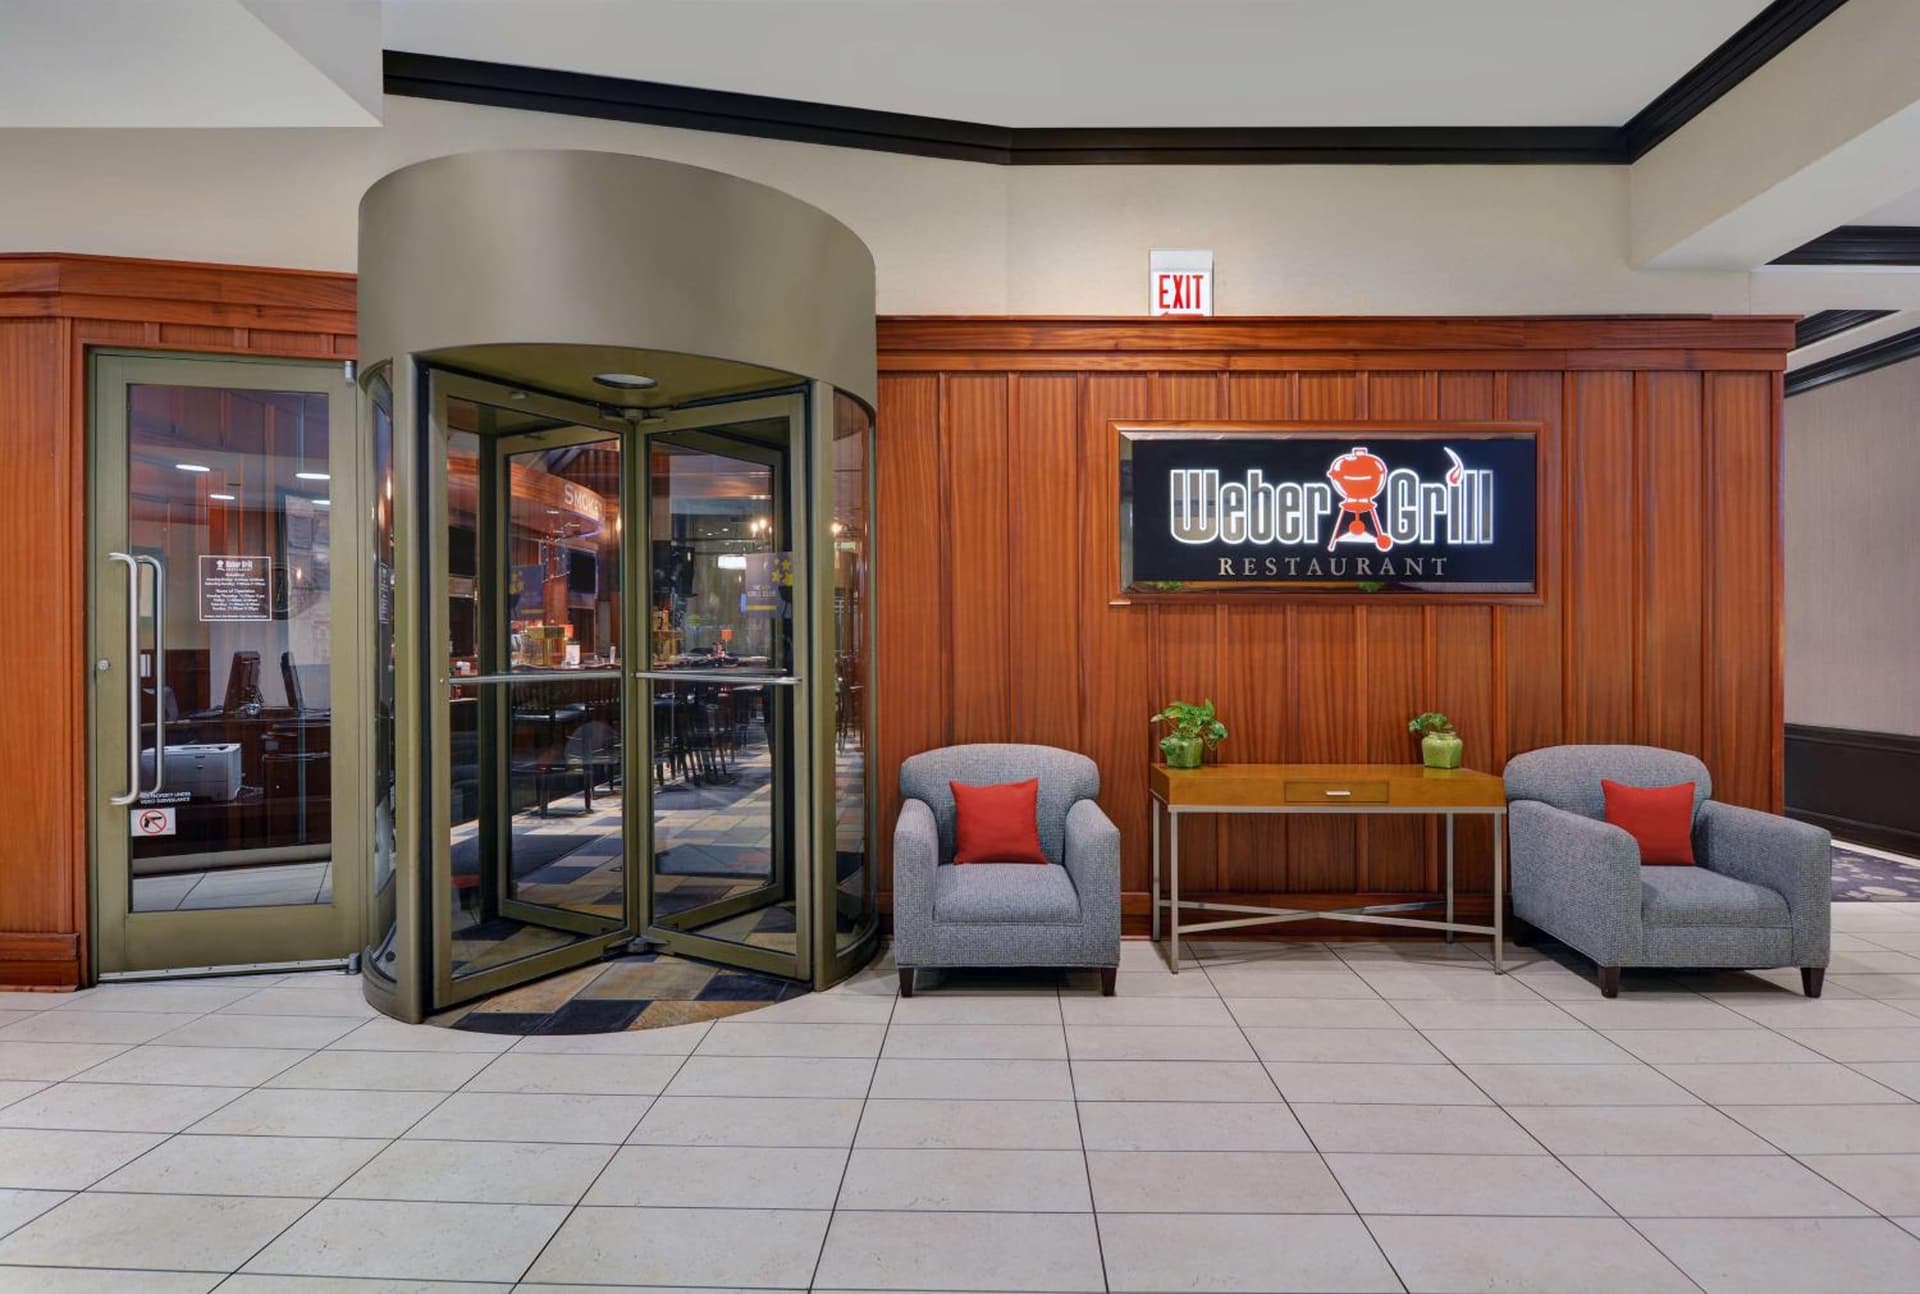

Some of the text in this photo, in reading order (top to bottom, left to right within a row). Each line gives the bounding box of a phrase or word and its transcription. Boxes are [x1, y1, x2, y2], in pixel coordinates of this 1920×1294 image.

[1159, 274, 1204, 309] EXIT
[1170, 446, 1493, 545] Weber Grill
[1218, 557, 1447, 576] RESTAURANT
